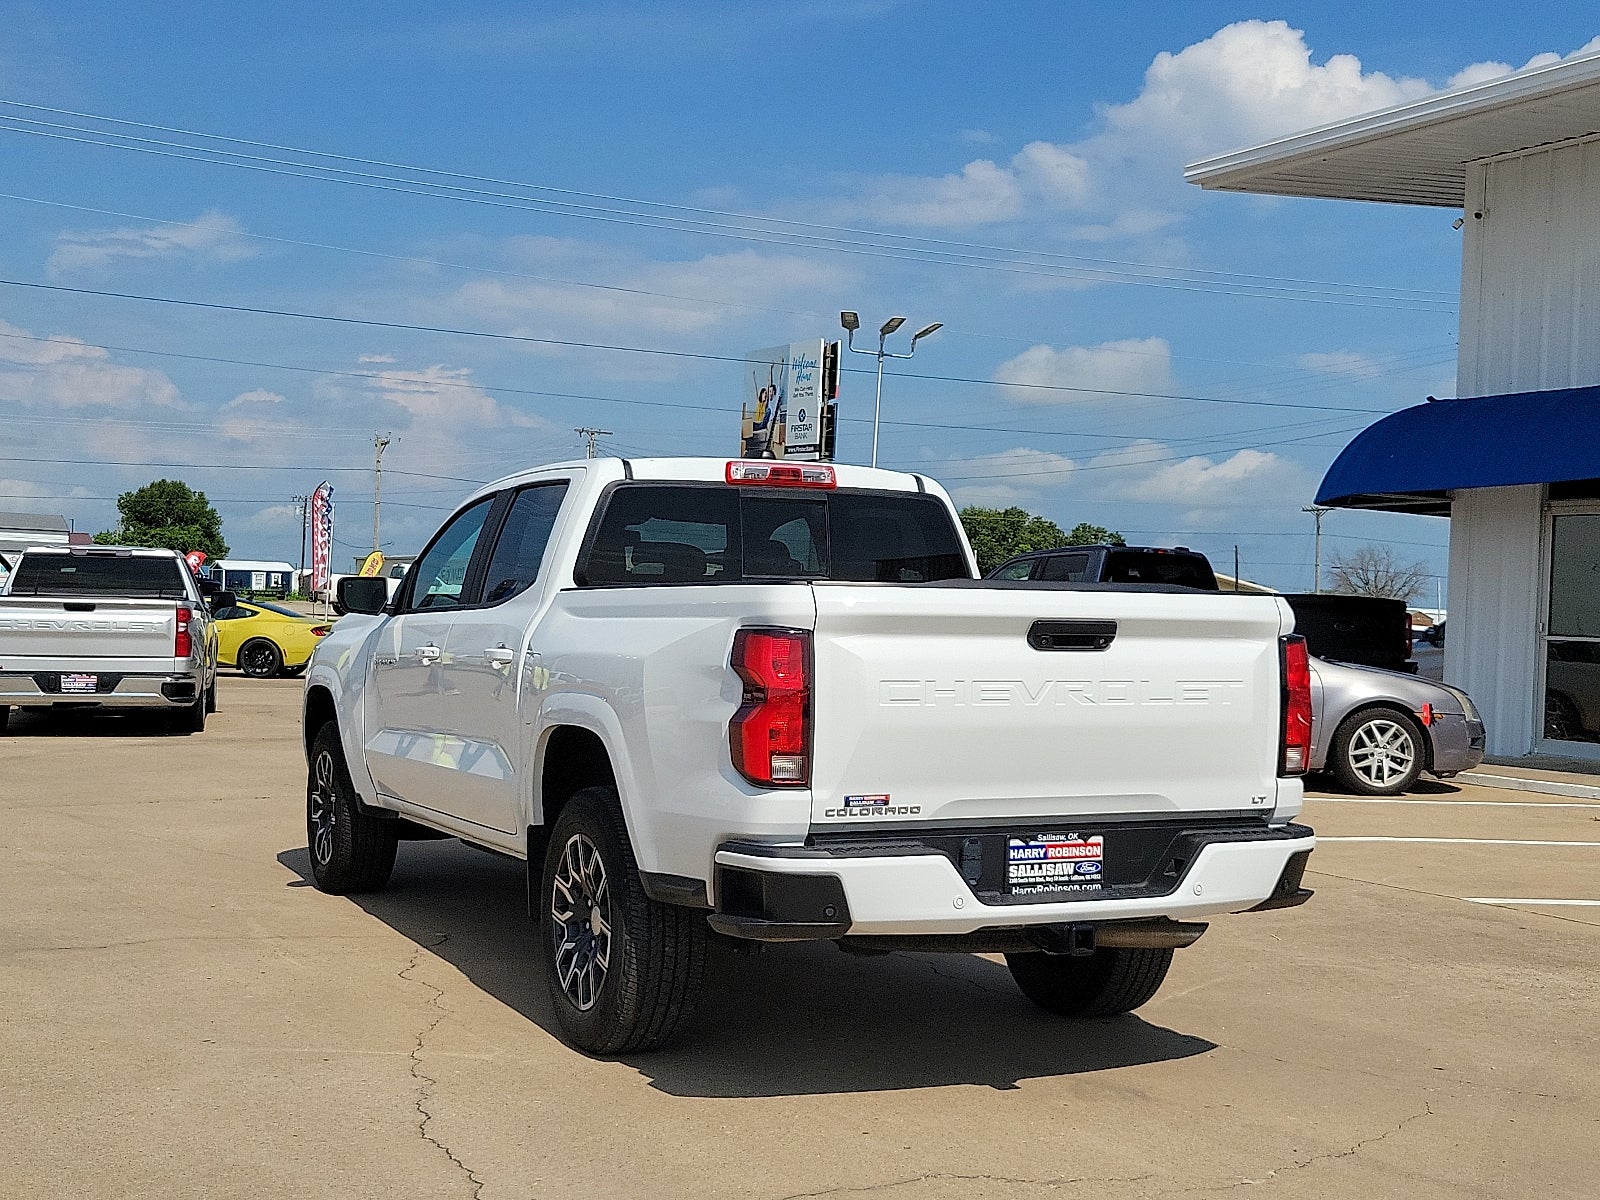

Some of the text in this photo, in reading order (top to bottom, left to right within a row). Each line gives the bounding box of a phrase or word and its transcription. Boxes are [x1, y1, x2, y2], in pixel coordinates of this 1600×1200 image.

[796, 370, 812, 385] Home
[791, 424, 813, 432] FIRSTAR
[795, 432, 808, 440] BANK
[880, 679, 1244, 707] CHEVROLET
[1251, 796, 1267, 805] LT
[825, 805, 921, 818] COLORADO
[1067, 832, 1079, 840] OK
[1010, 845, 1101, 859] HARRY ROBINSON
[1009, 863, 1075, 877] SALLISAW
[1012, 883, 1102, 895] HarryRobinson.com
